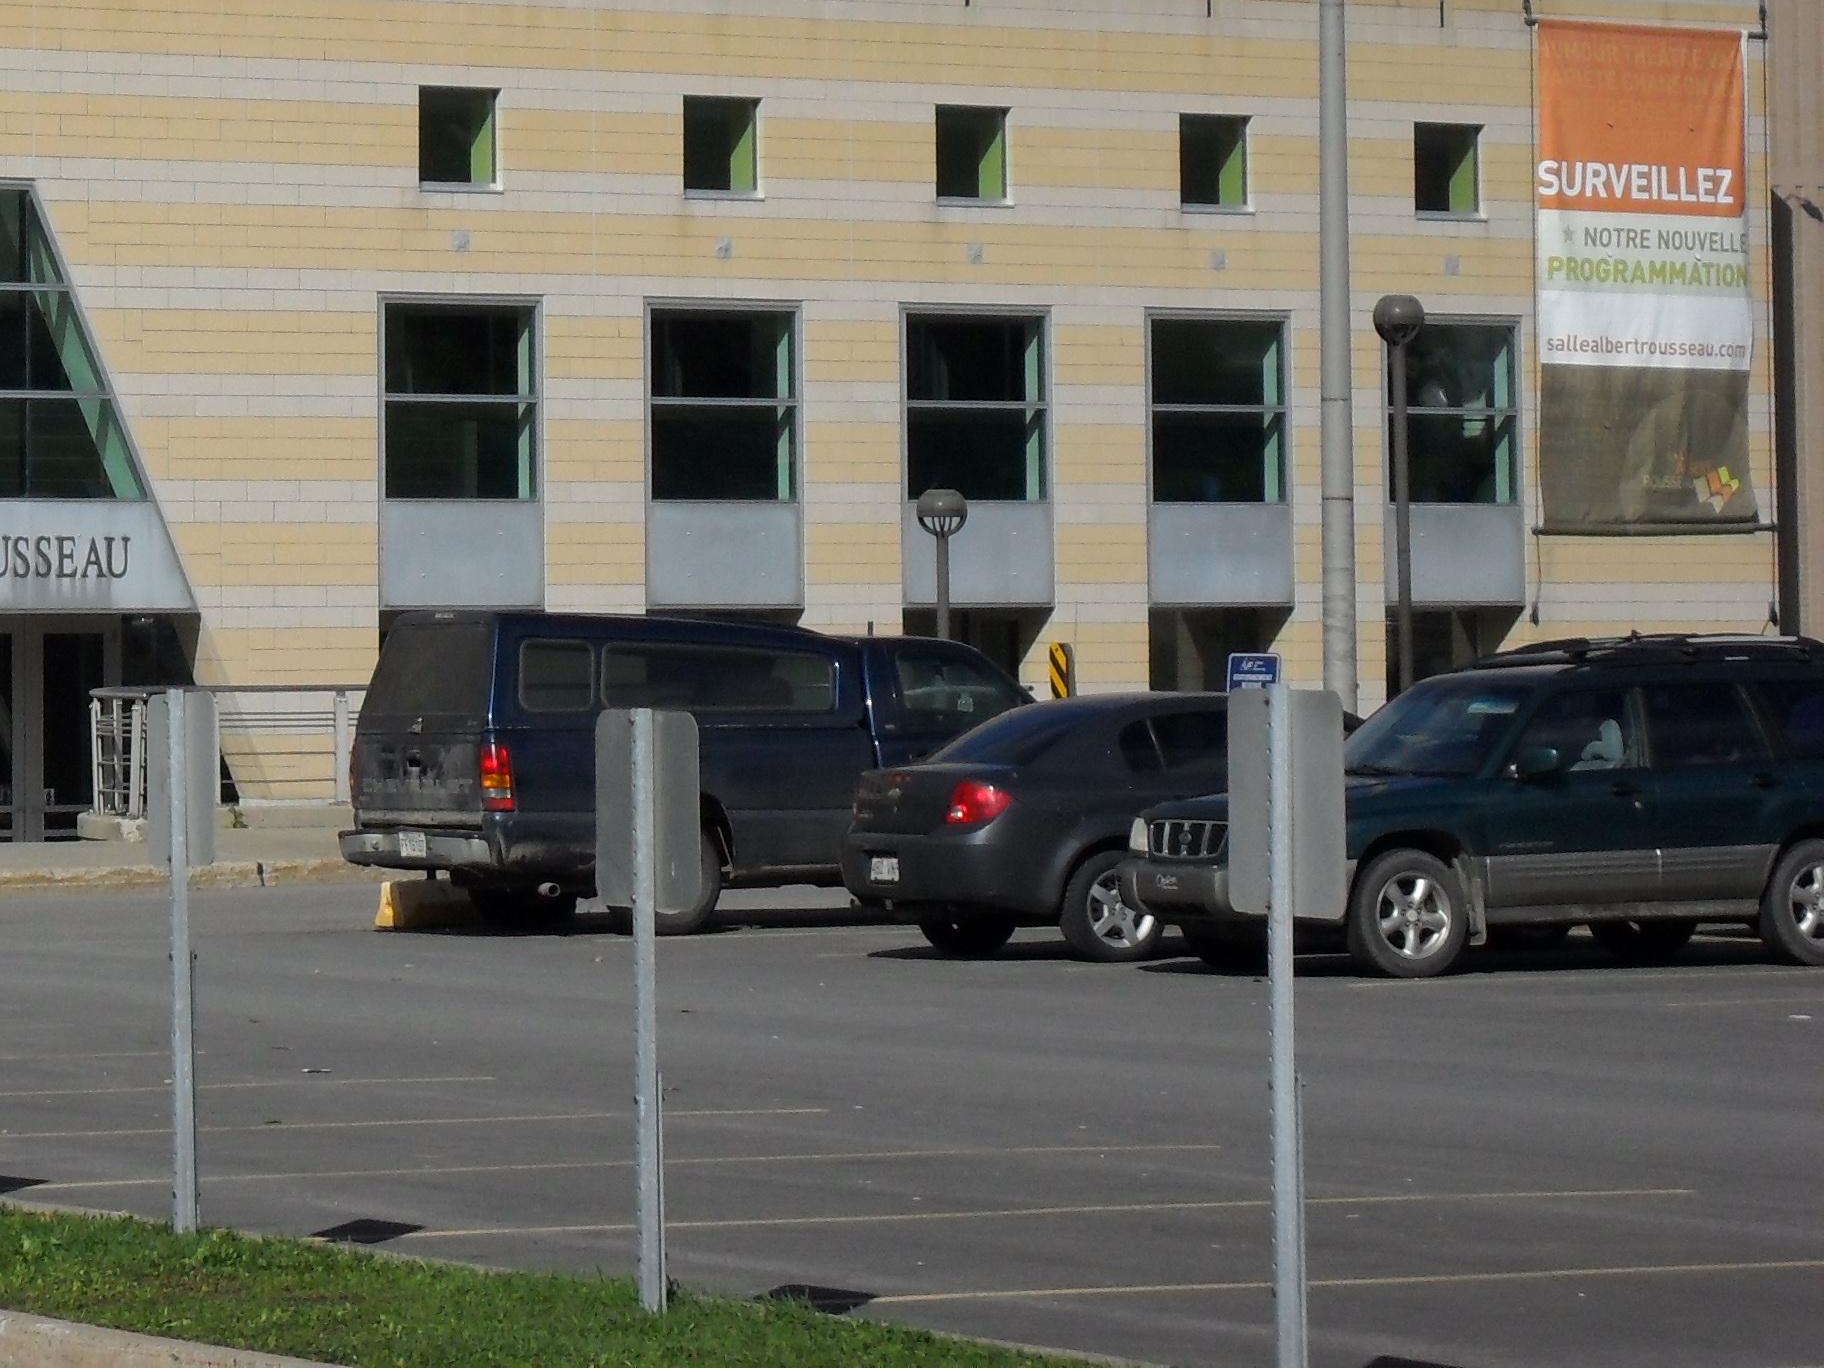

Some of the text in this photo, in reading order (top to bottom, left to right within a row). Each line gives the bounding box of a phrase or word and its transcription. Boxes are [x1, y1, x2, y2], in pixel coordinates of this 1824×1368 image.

[1538, 160, 1734, 203] SURVEILLEZ
[1584, 227, 1747, 253] NOTRE NOUVELLE
[1547, 256, 1748, 288] PROGRAMMATION
[1547, 335, 1746, 358] sallealbertrousseau.com
